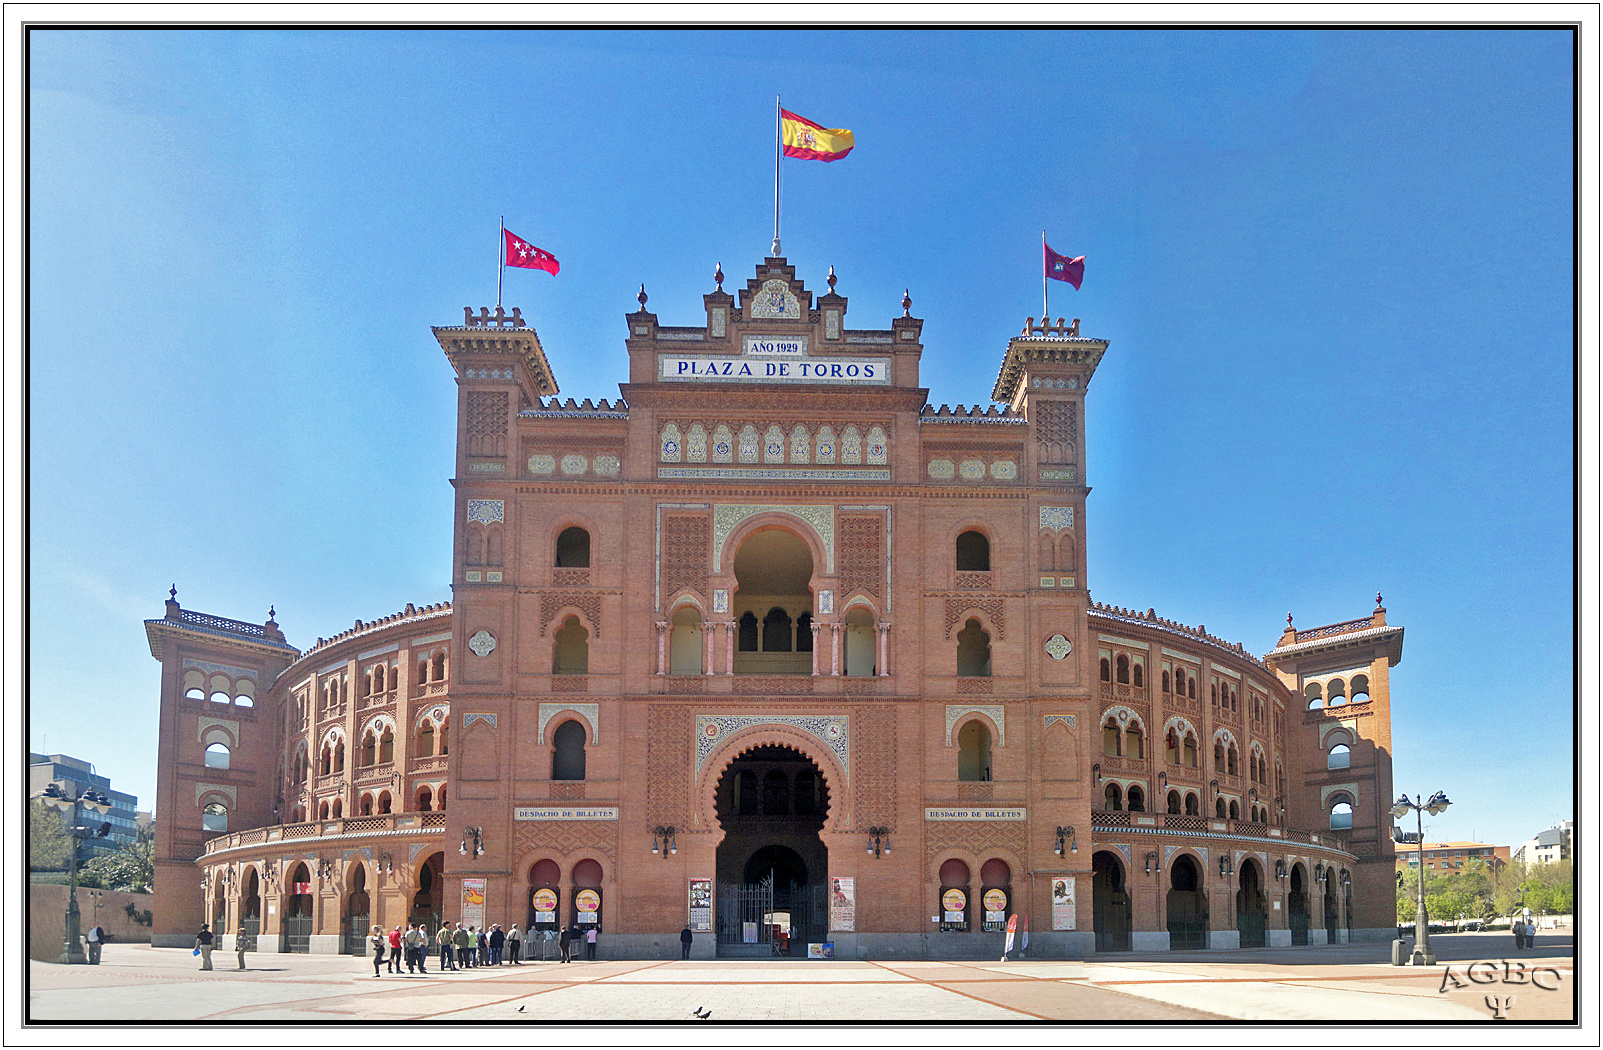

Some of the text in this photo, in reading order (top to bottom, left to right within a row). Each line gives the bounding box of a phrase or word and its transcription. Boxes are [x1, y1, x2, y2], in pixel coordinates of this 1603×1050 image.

[751, 341, 798, 352] AÑO 1929
[677, 361, 874, 377] PLAZA DE TOROS
